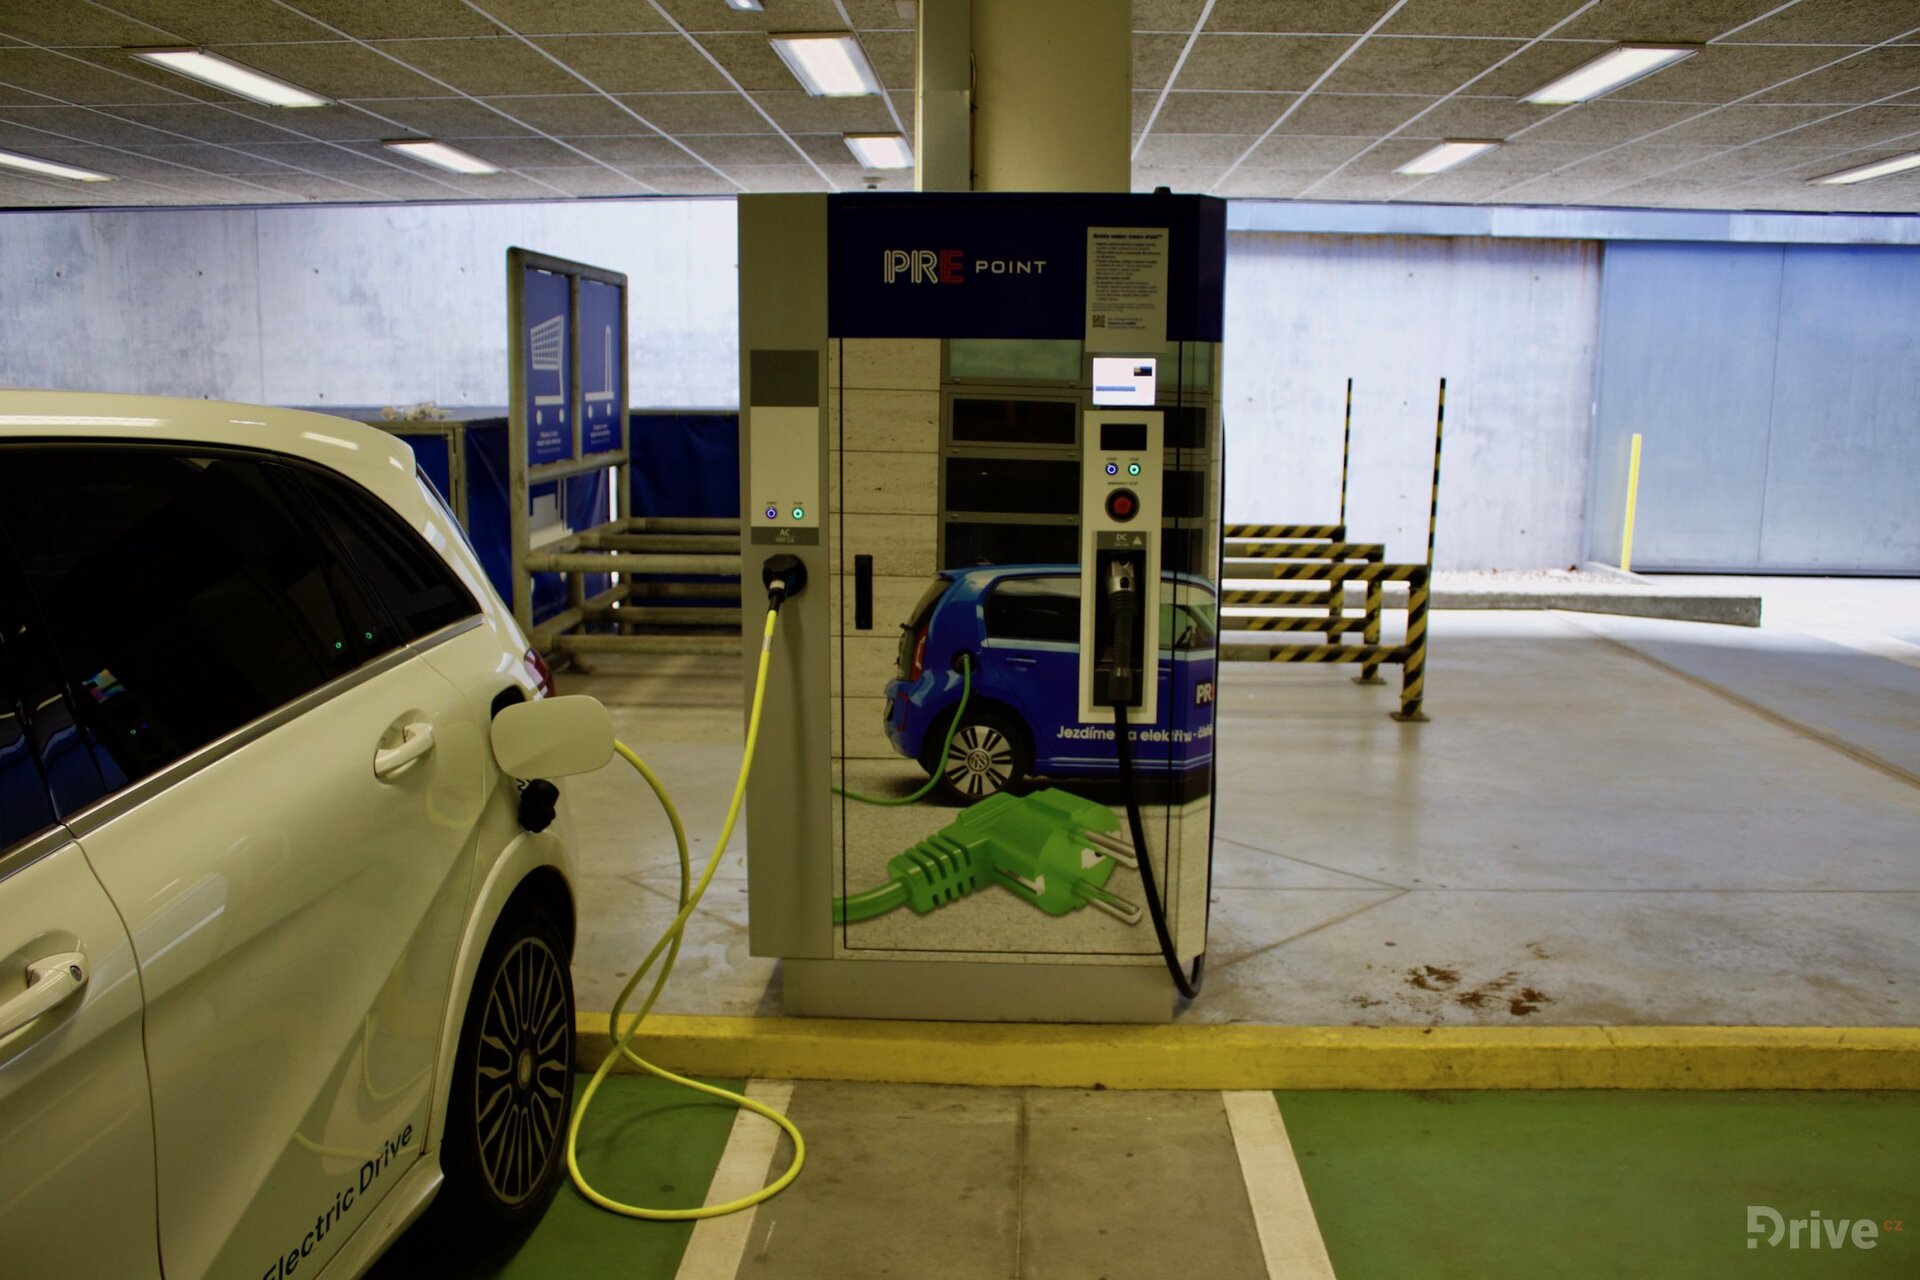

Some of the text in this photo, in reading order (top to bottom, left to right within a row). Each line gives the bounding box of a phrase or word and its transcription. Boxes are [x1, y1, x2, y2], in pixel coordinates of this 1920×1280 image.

[884, 250, 1046, 283] PRE POINT
[1116, 533, 1127, 541] DC
[1196, 683, 1215, 704] PR
[1057, 726, 1115, 740] Jezdíme
[359, 1124, 412, 1195] Drive
